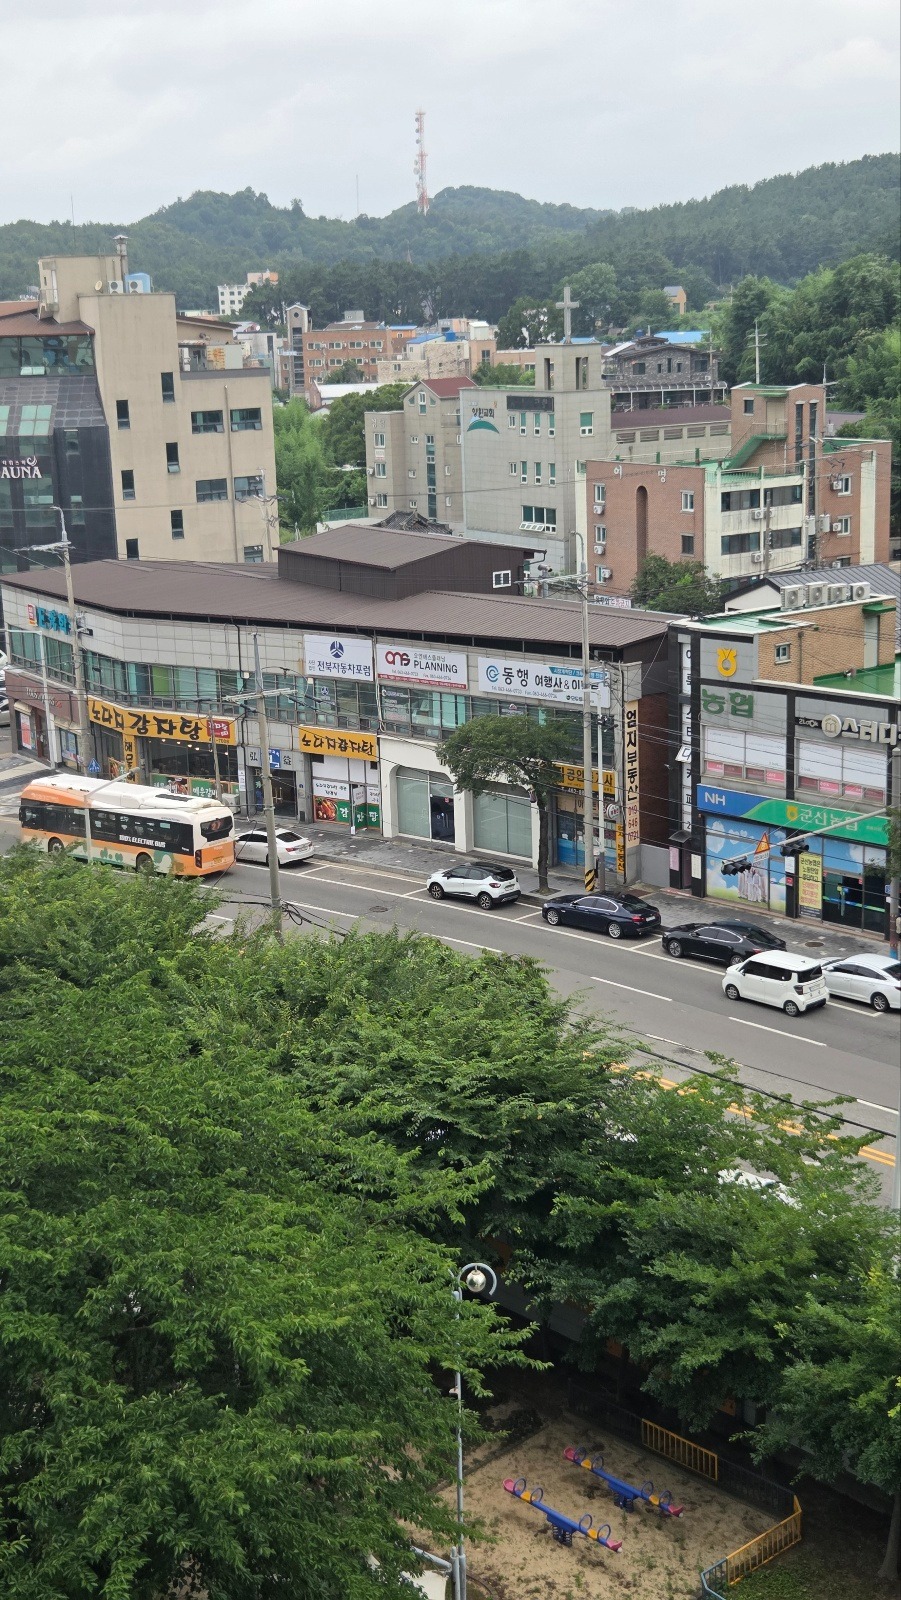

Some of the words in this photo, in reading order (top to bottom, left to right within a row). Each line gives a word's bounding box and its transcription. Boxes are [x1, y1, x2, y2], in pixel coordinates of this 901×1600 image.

[317, 660, 371, 677] 전북자동차포럼
[413, 660, 458, 674] PLANNING
[502, 667, 529, 687] 동행
[534, 674, 562, 689] 여행사
[563, 680, 570, 690] &
[701, 689, 754, 718] 농협
[127, 712, 203, 740] 감자탕
[704, 791, 726, 806] NH
